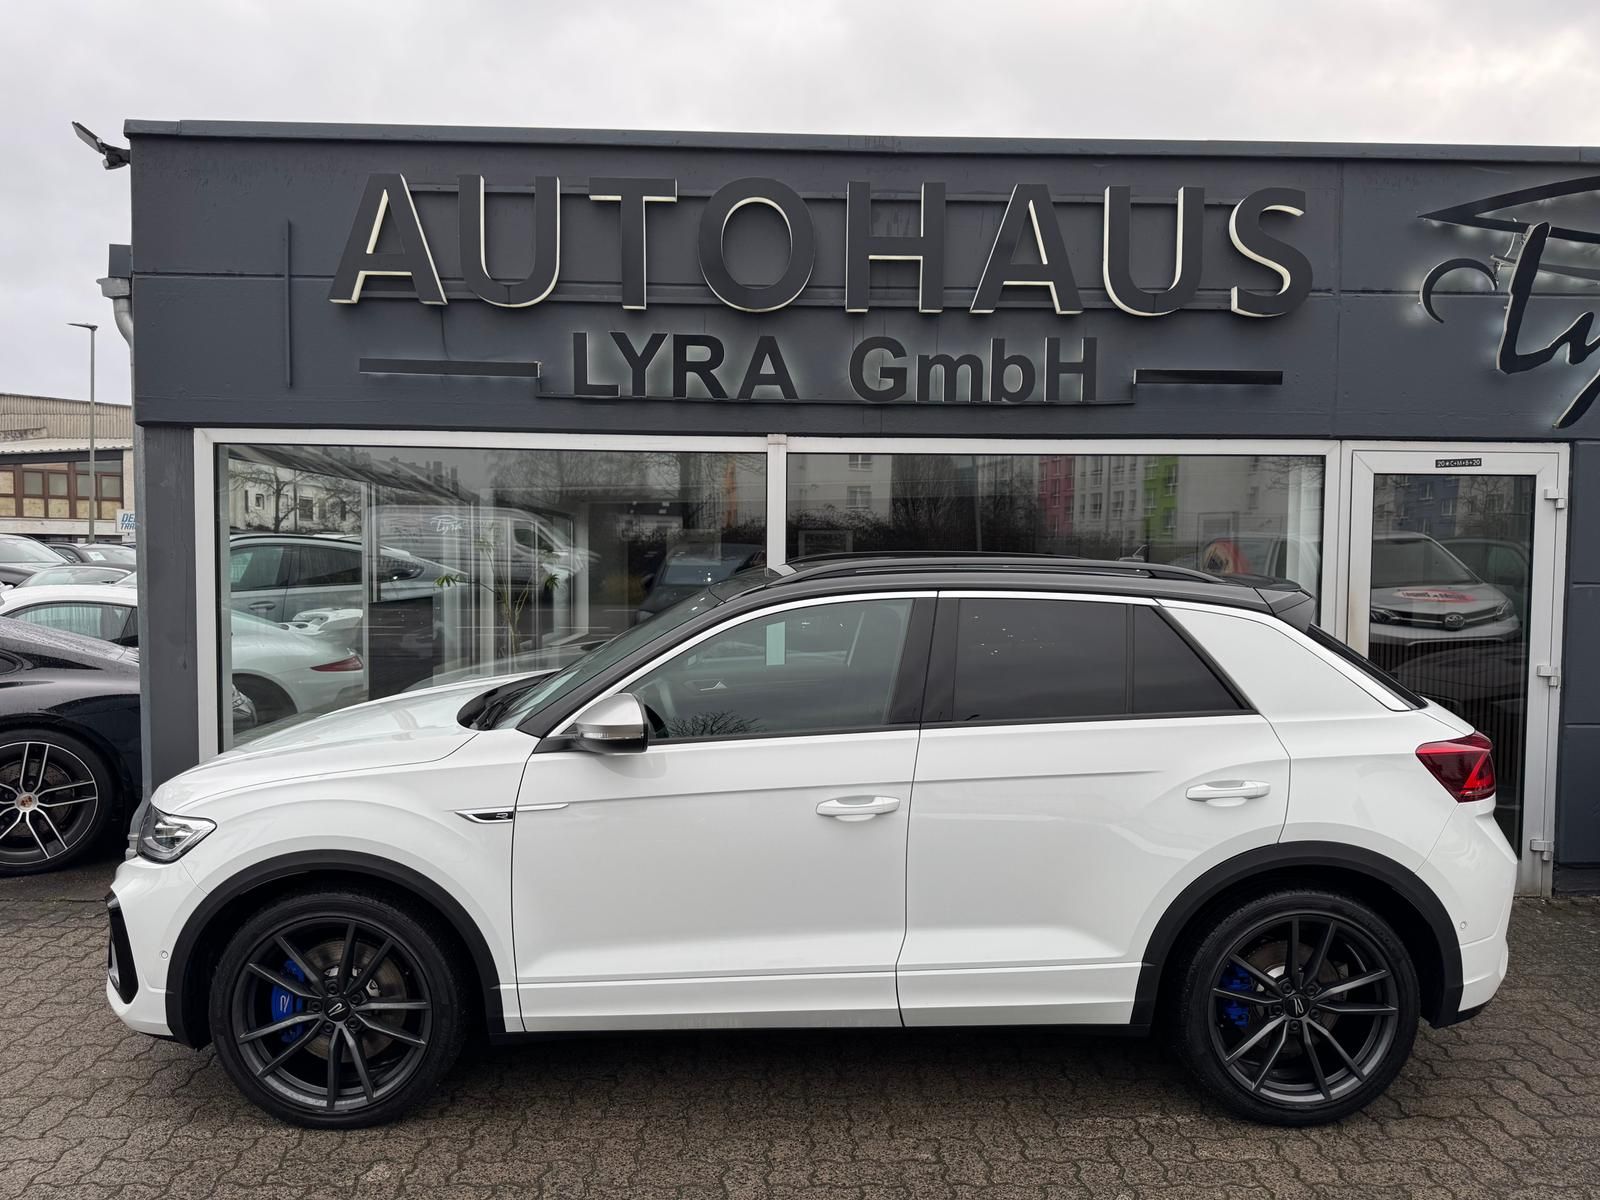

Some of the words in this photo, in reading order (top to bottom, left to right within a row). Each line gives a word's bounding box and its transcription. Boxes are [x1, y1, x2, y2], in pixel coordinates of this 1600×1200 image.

[329, 173, 1313, 317] AUTOHAUS
[572, 330, 800, 400] LYRA
[847, 335, 1098, 402] GmbH
[120, 522, 136, 530] TRA
[121, 513, 136, 523] DE
